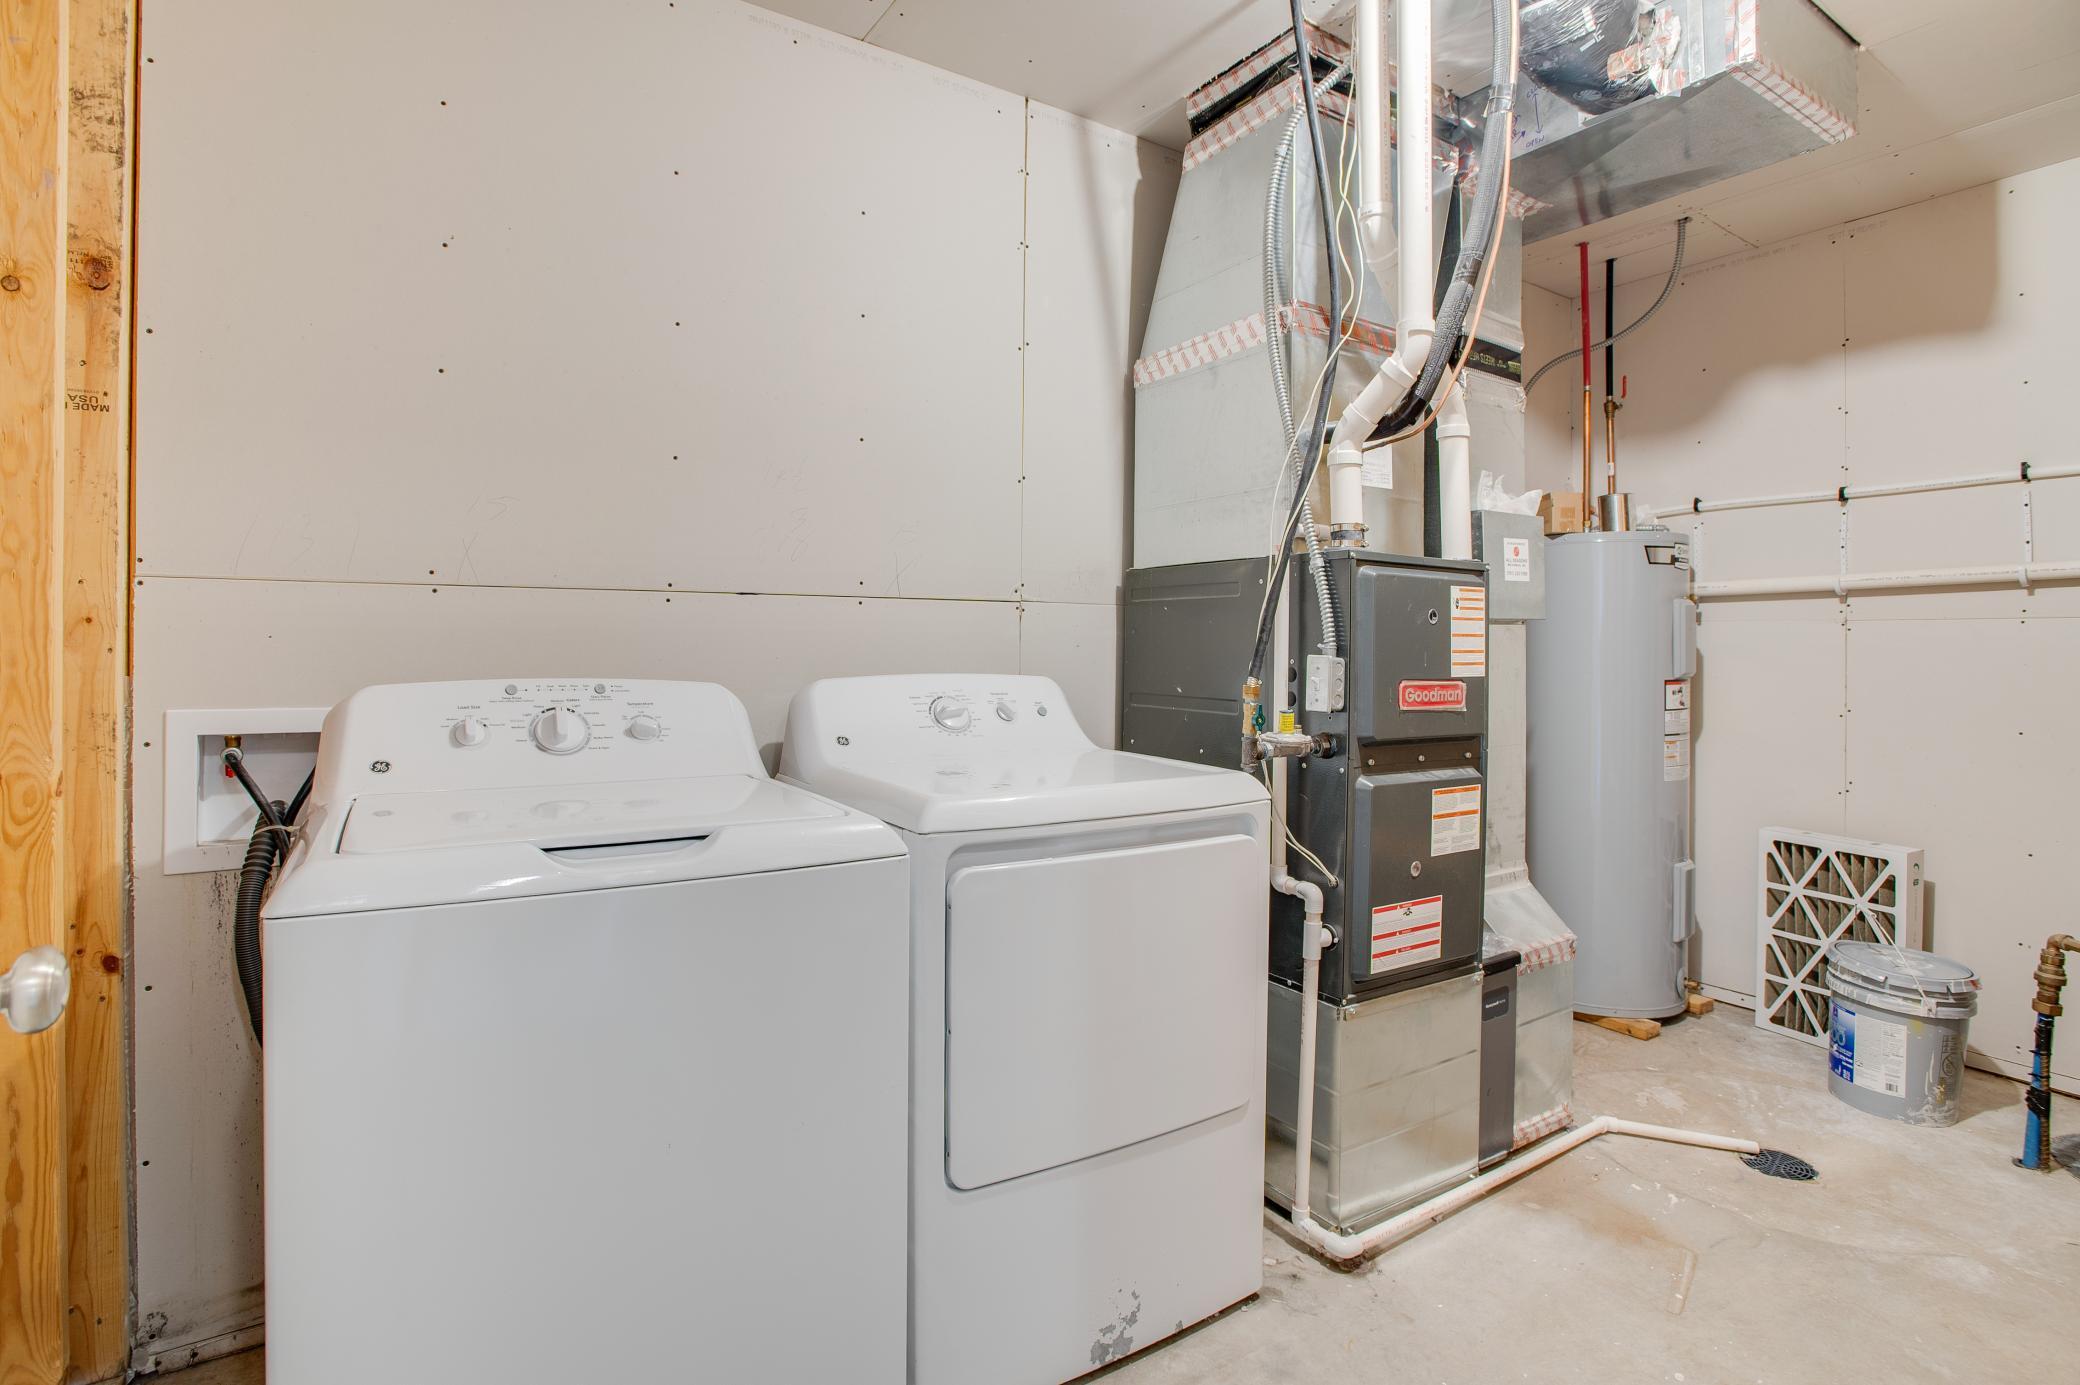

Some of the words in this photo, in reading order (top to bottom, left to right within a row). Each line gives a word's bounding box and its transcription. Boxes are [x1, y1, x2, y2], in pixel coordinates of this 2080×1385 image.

[67, 393, 98, 403] USA
[72, 402, 110, 412] MADE
[1405, 684, 1462, 703] Goodman
